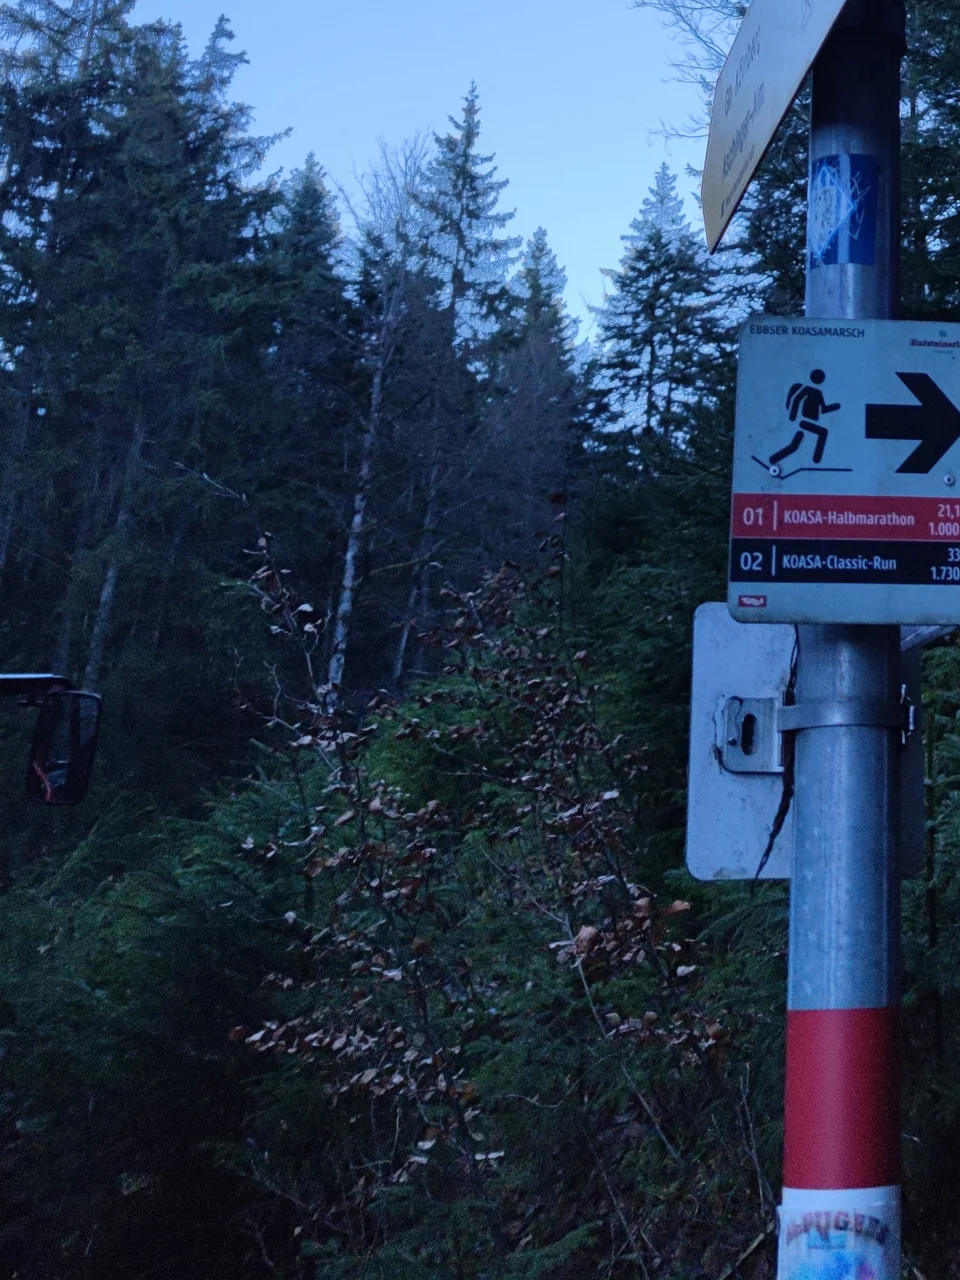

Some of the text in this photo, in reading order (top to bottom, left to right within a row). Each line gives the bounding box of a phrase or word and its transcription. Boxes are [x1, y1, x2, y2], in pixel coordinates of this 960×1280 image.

[749, 324, 865, 339] EBBSER KOASAMARSCH
[742, 506, 765, 526] 01
[783, 509, 915, 527] KOASA-Halbmarathon
[937, 503, 960, 520] 21,1
[928, 522, 960, 537] 1.000
[739, 551, 763, 571] 02
[782, 553, 897, 570] KOASA-Classic-Run
[946, 547, 960, 562] 33
[930, 566, 960, 581] 1.730
